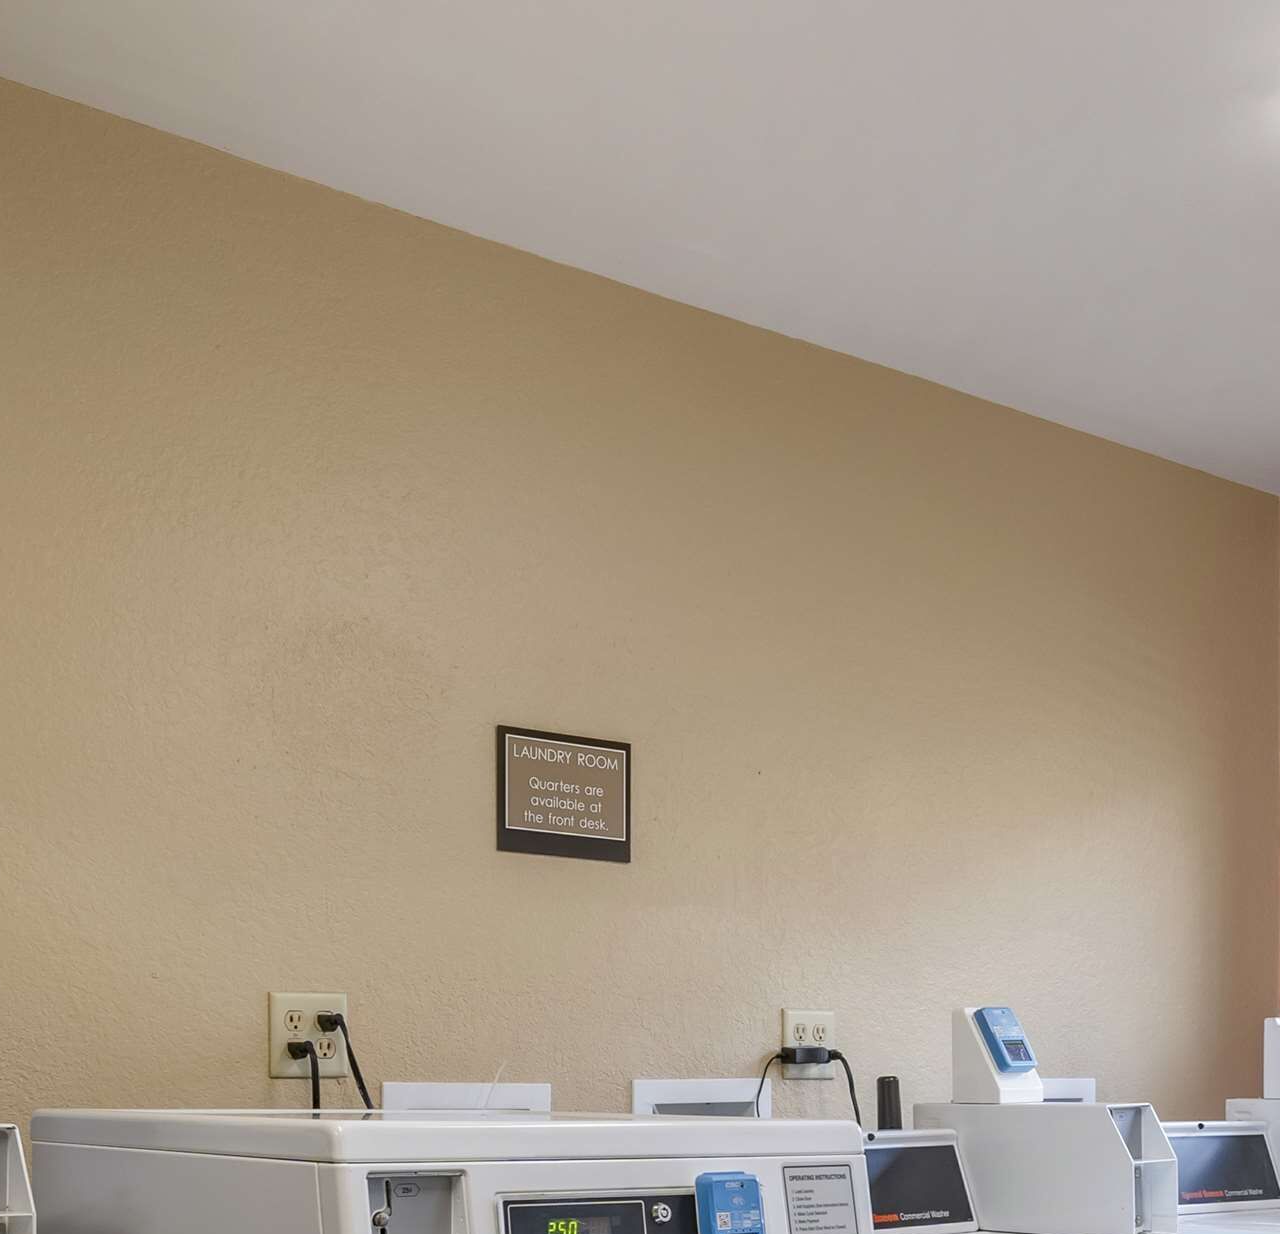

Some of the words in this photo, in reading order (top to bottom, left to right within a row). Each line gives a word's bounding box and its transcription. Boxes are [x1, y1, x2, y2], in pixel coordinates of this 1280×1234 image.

[513, 744, 572, 764] LAUNDRY
[578, 752, 618, 771] ROOM
[529, 776, 580, 794] Quarters
[585, 786, 604, 797] are
[531, 795, 585, 811] available
[590, 802, 602, 813] at
[524, 810, 543, 824] the
[548, 813, 574, 827] front
[580, 817, 609, 831] desk.
